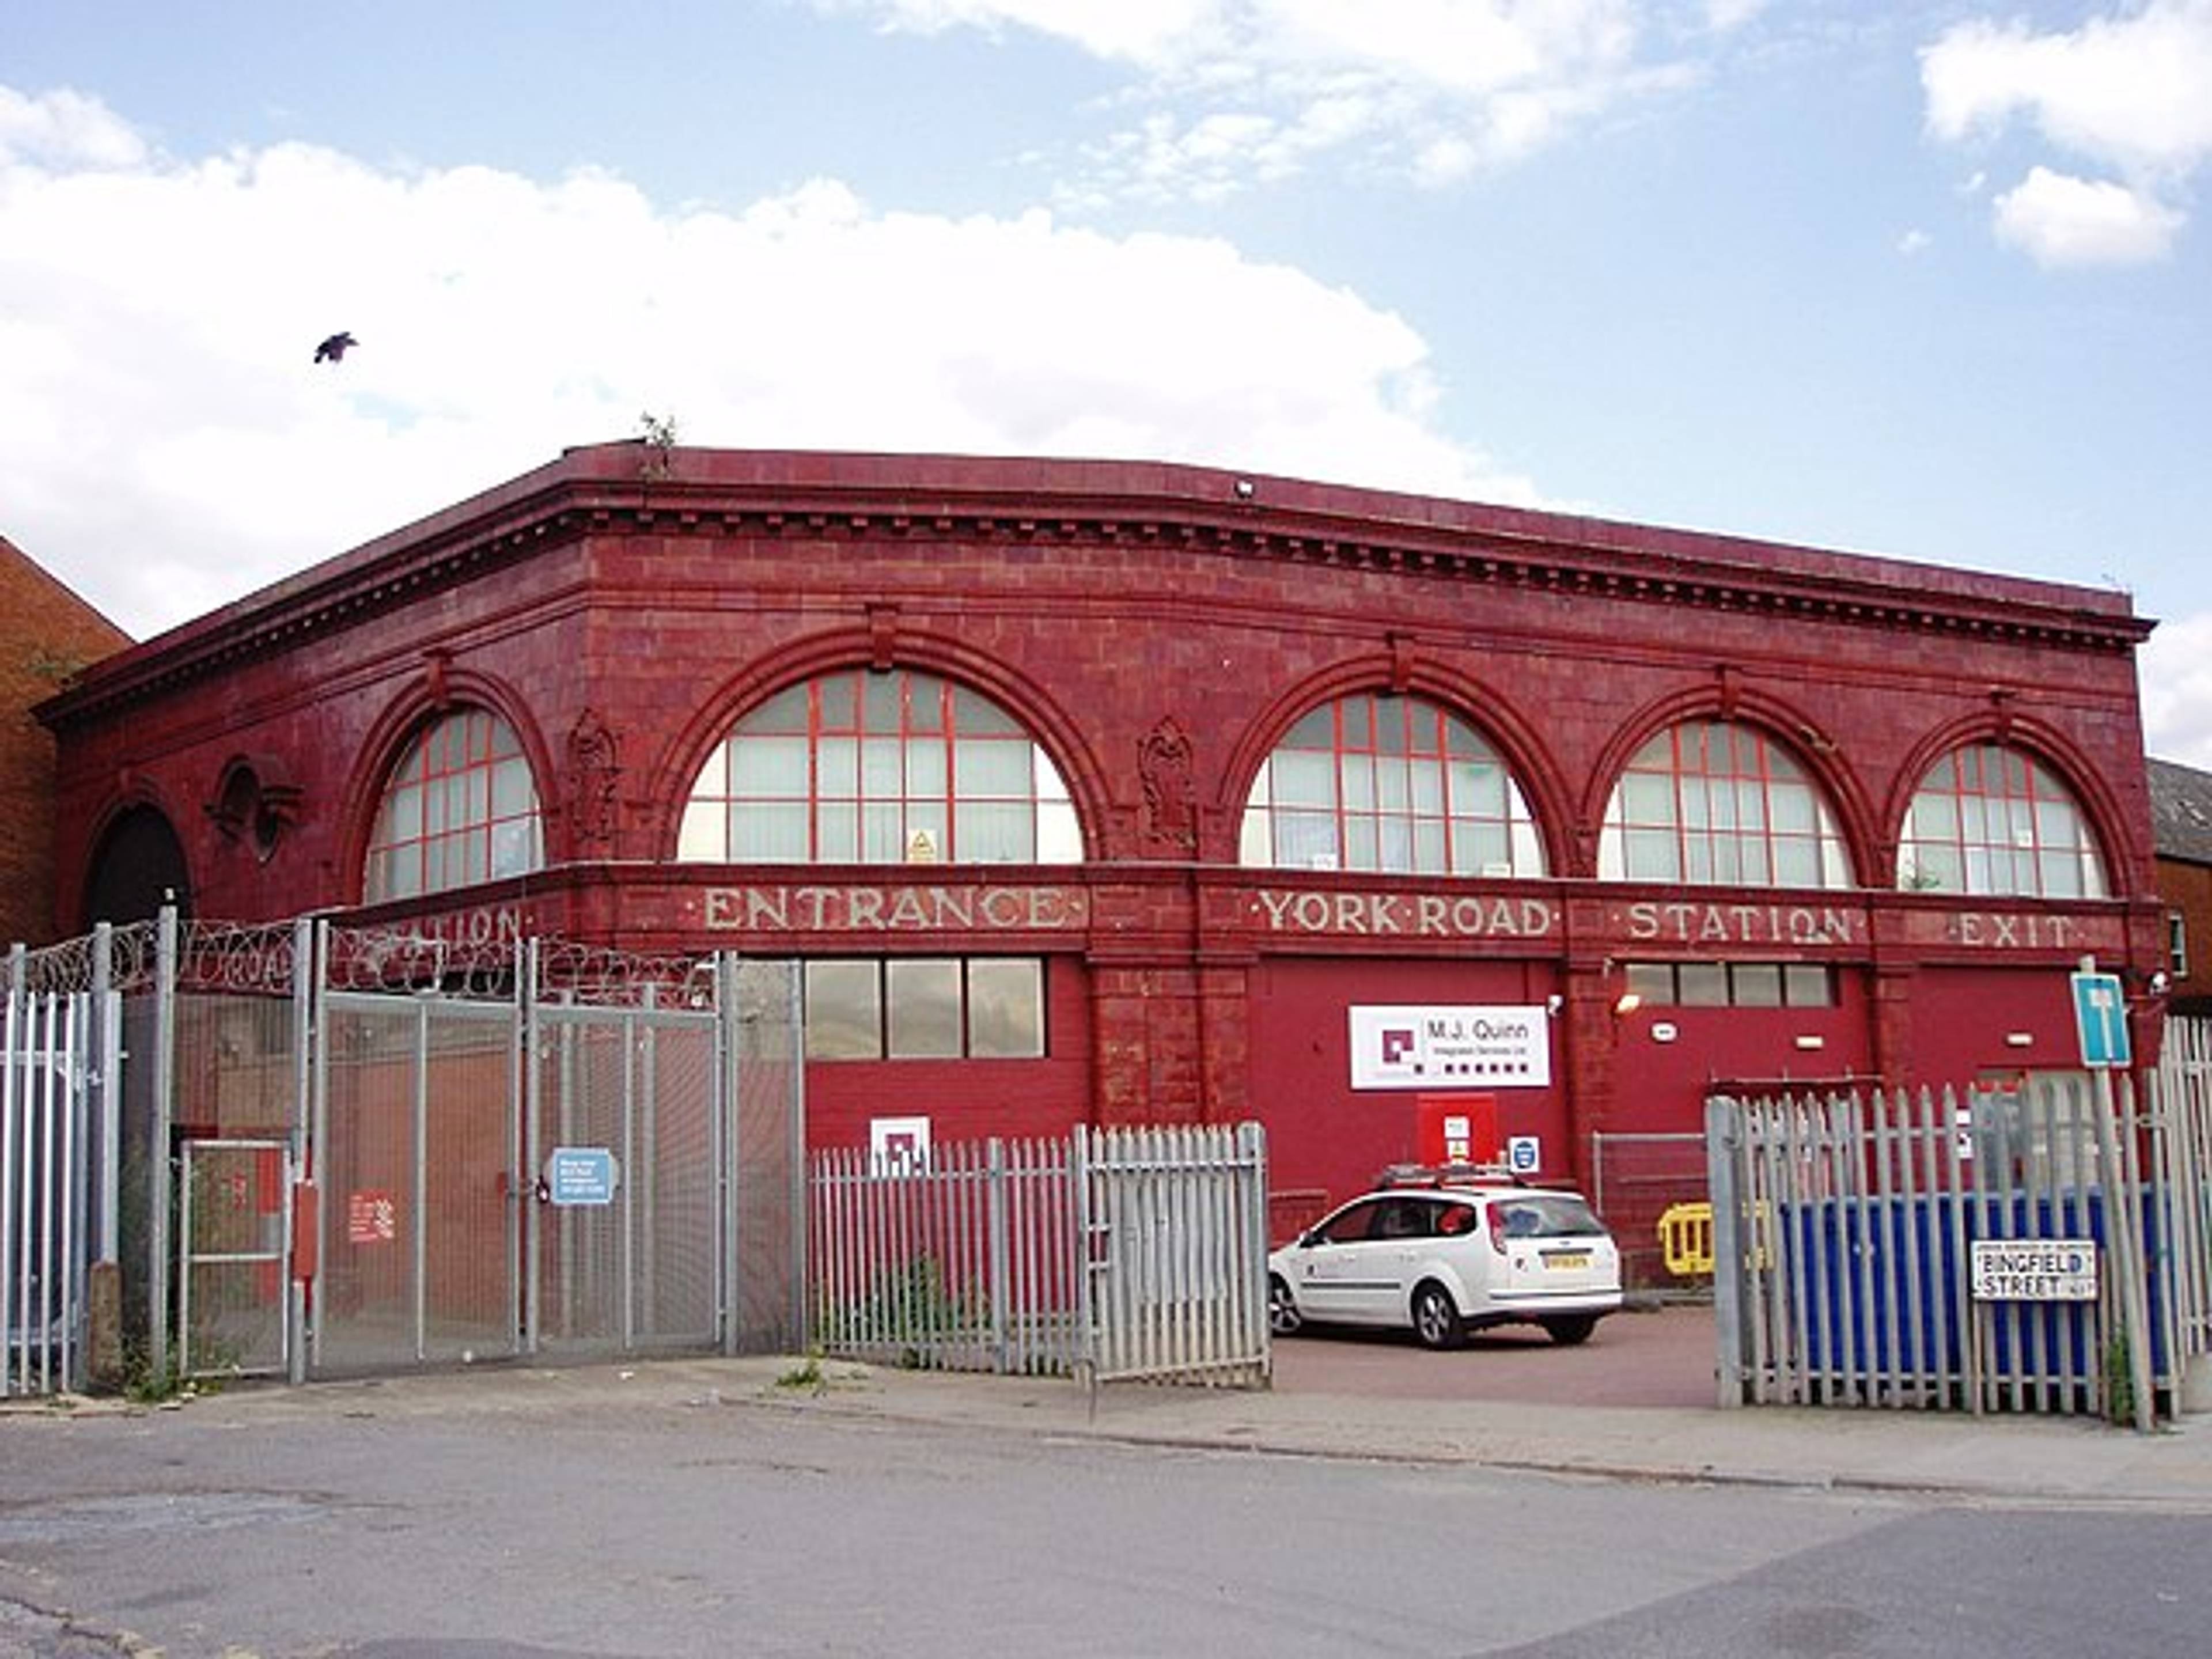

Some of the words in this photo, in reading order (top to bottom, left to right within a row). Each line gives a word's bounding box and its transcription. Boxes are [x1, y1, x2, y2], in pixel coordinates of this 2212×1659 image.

[703, 887, 1066, 930] ENTRANCE
[1259, 891, 1401, 933] YORK
[1417, 895, 1550, 936] ROAD
[1630, 902, 1851, 944] STATION
[1960, 912, 2072, 948] EXIT
[1472, 1019, 1528, 1040] Quinn
[1983, 1275, 2061, 1294] STREET
